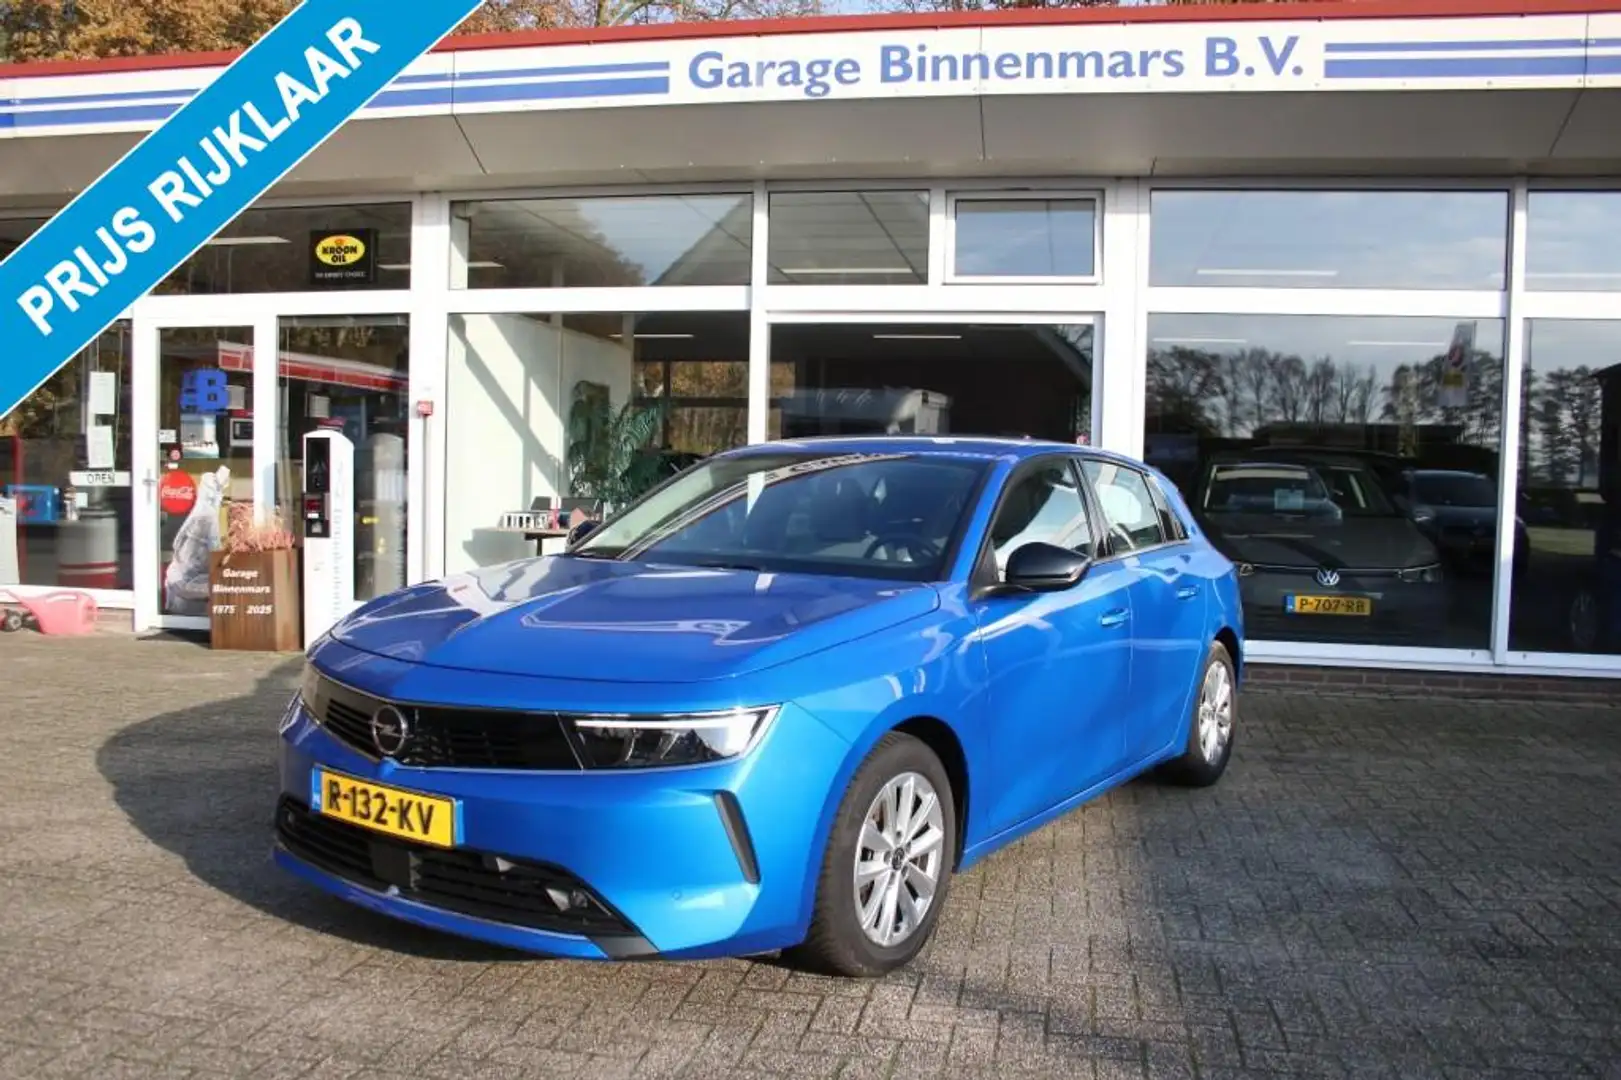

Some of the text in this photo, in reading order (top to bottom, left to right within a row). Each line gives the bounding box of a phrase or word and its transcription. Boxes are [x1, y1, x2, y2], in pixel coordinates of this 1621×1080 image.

[688, 35, 1304, 98] Garage Binnenmars B.V.
[321, 245, 358, 255] KROON
[330, 253, 346, 263] OIL
[86, 472, 116, 485] OPEN
[222, 568, 259, 580] Garage
[211, 584, 272, 594] Binnenmars
[211, 604, 273, 615] 1975 2025
[328, 779, 434, 835] R-132-KV
